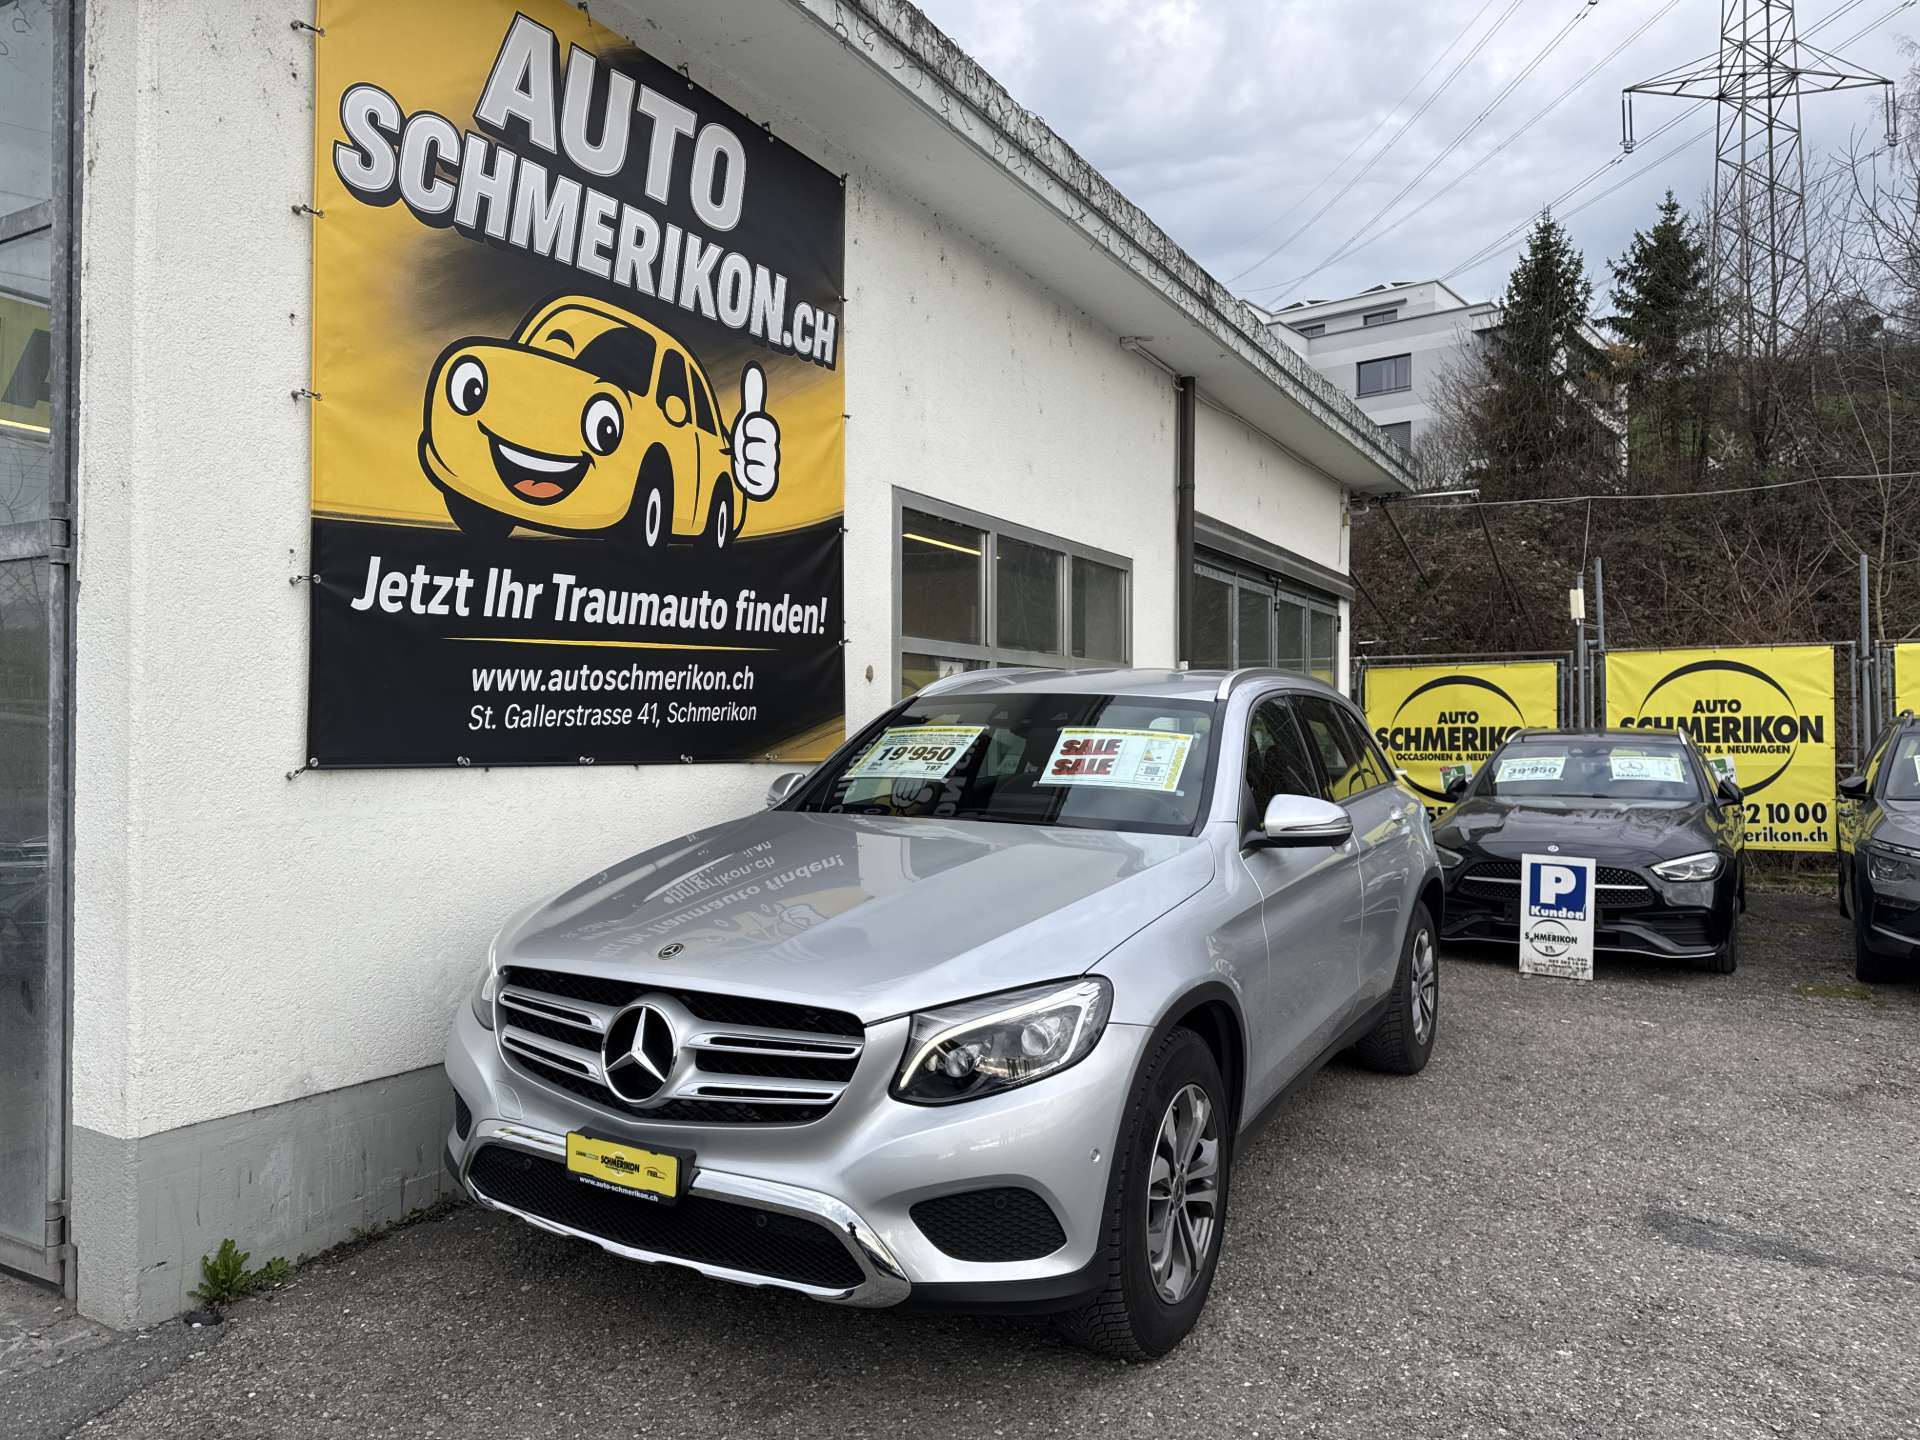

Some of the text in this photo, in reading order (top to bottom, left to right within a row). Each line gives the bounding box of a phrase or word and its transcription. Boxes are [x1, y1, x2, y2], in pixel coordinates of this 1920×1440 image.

[475, 10, 746, 232] AUTO
[333, 82, 838, 371] SCHMERIKON.CH
[351, 555, 828, 635] Jetzt Ihr Traumauto finden!
[471, 663, 755, 692] www.autoschmerikon.ch
[1692, 699, 1741, 714] AUTO
[468, 701, 757, 731] St. Gallerstrasse 41, Schmerikon
[1437, 710, 1479, 725] AUTO
[1060, 738, 1122, 756] SALE
[1375, 726, 1523, 752] SCHMERIK
[878, 746, 955, 761] 19'950
[1396, 752, 1453, 761] OCCASIONEN
[1455, 752, 1463, 761] &
[1715, 745, 1723, 753] &
[1727, 745, 1790, 754] NEUWAGEN
[1052, 758, 1115, 776] SALE
[1766, 804, 1790, 824] 10
[1795, 803, 1827, 824] 00
[1530, 905, 1585, 920] Kunden
[1524, 932, 1577, 945] SHMERIKON
[601, 1155, 640, 1172] SCHMERIKON
[579, 1177, 658, 1202] www.auto-schmerikon.ch
